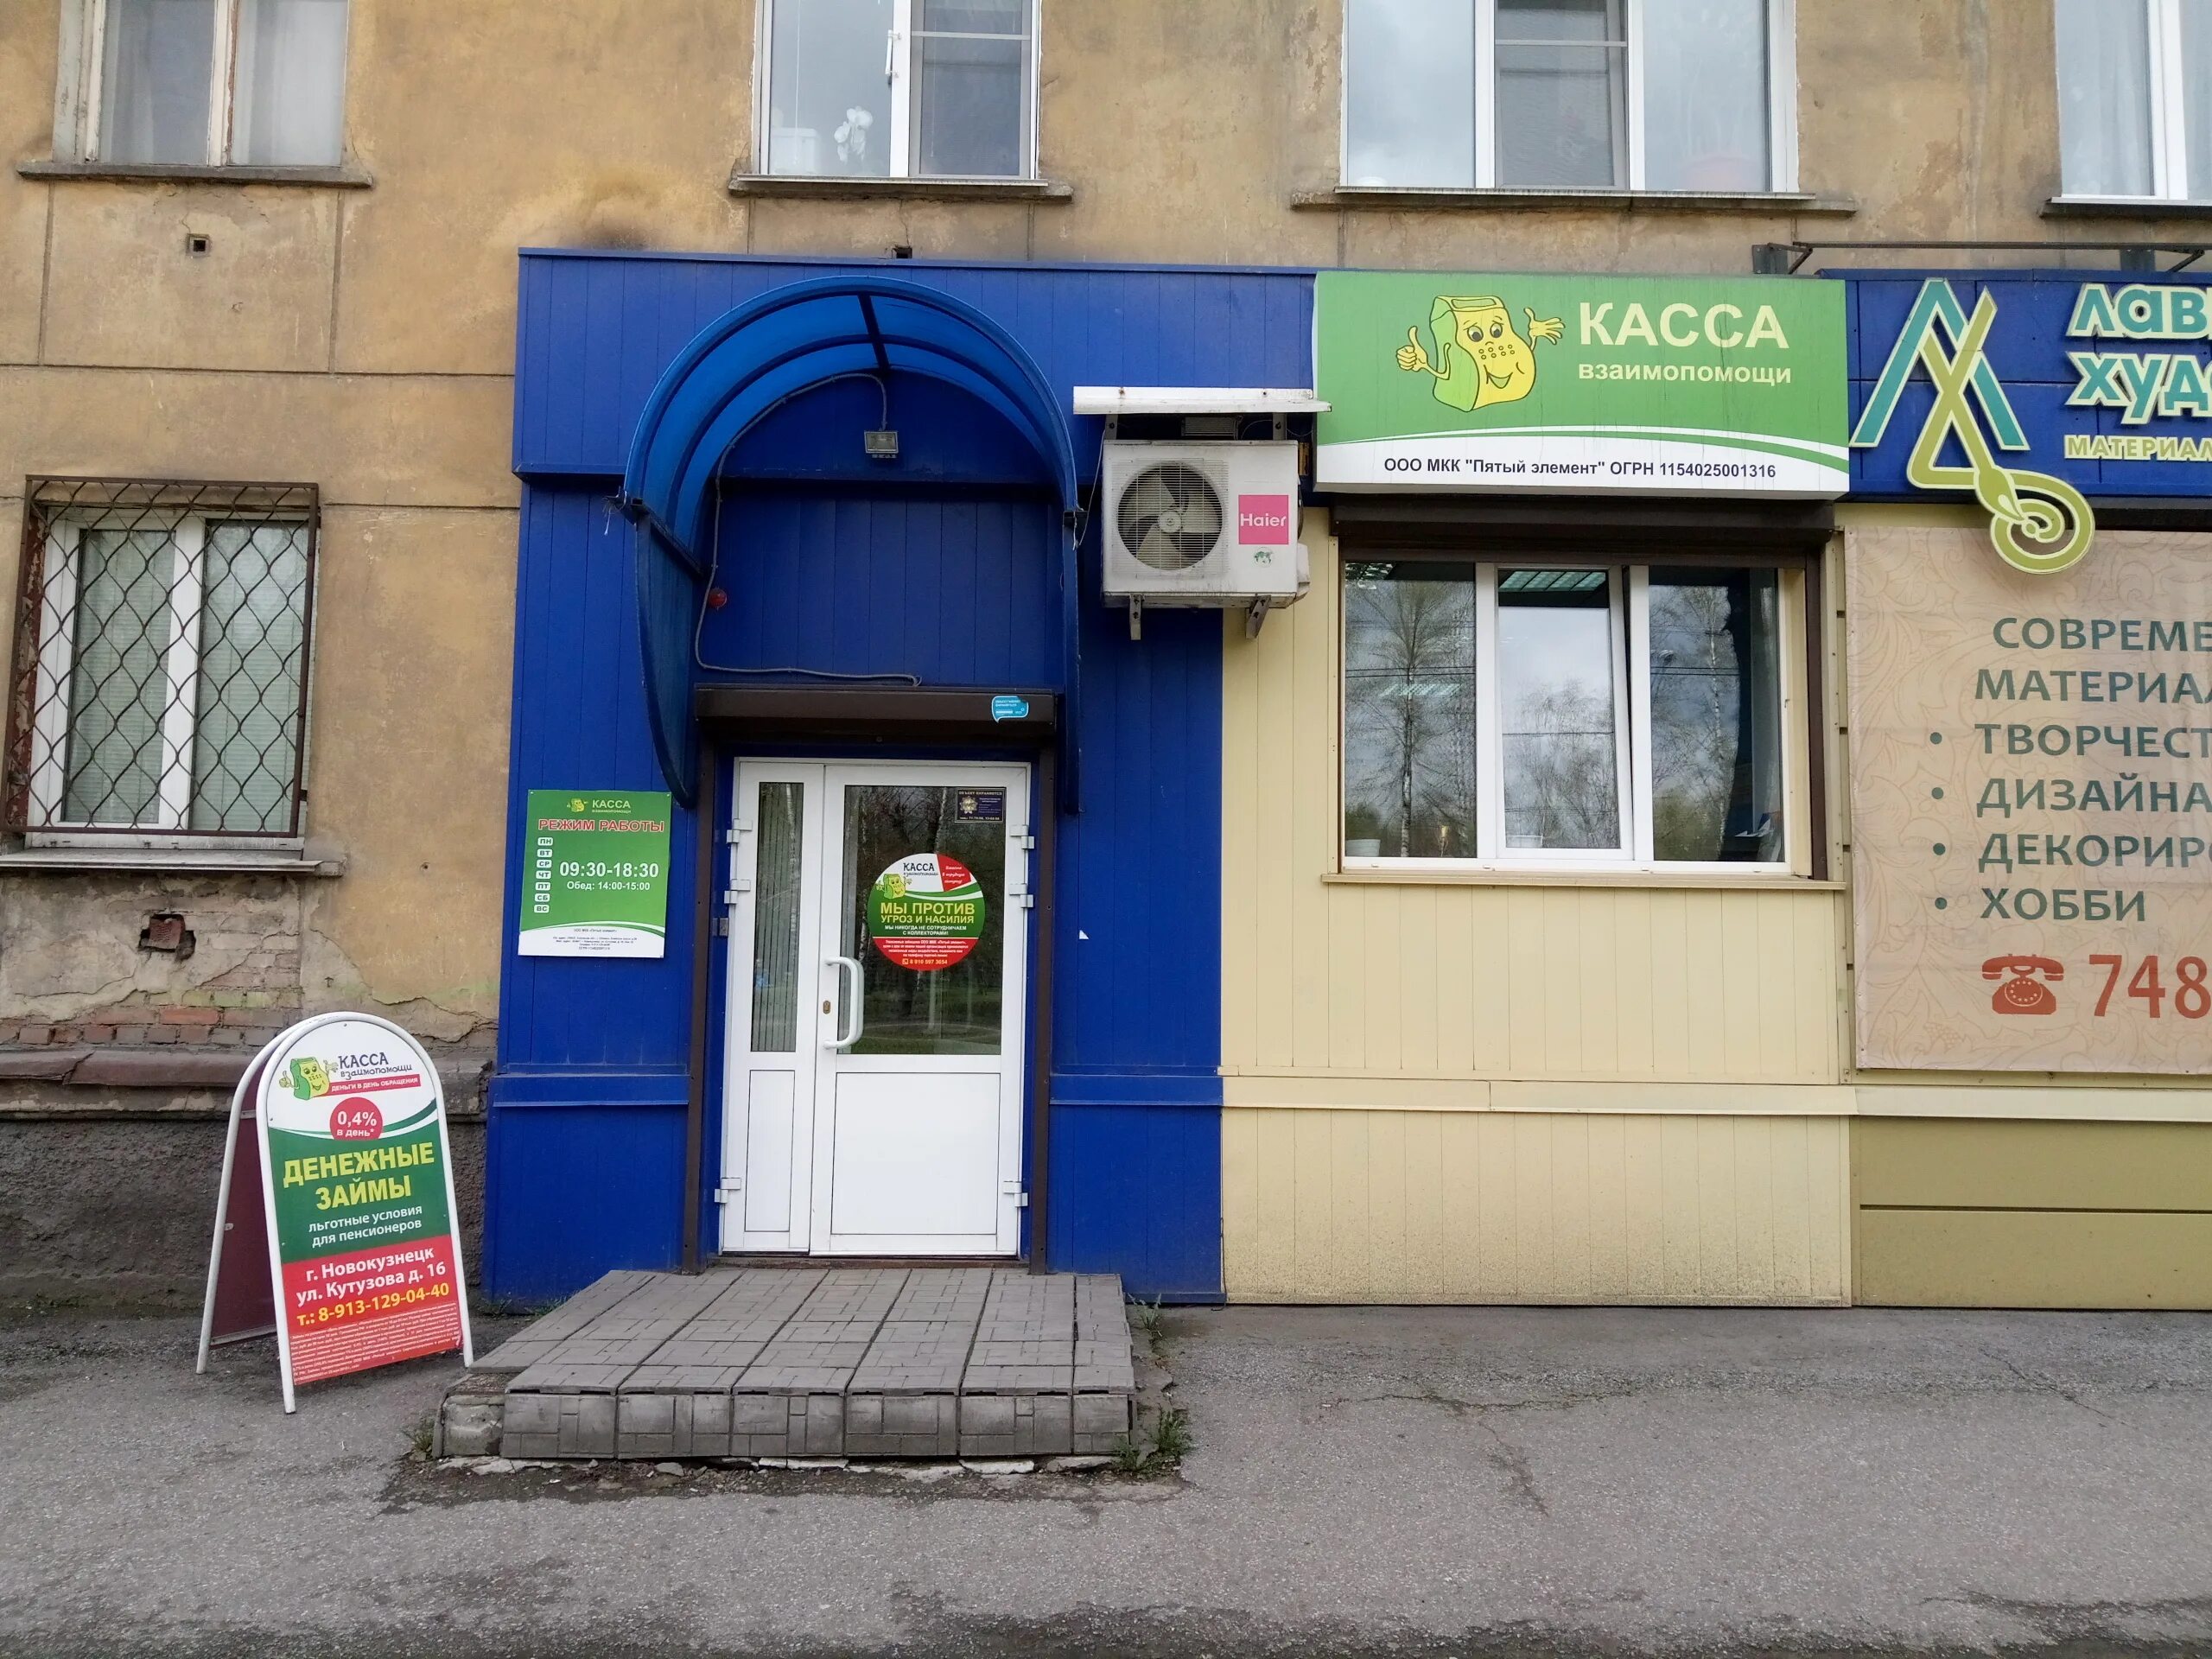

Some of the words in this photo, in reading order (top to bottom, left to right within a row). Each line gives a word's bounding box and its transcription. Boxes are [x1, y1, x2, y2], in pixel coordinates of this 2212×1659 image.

[1580, 302, 1789, 349] КАССА
[1579, 363, 1792, 387] взаимопомощи
[1384, 458, 1422, 472] ООО
[1427, 459, 1461, 472] МКК
[1465, 459, 1526, 474] "Пятый
[1531, 461, 1605, 474] элемент"
[1610, 461, 1654, 475] ОГРН
[1659, 462, 1777, 478] 1154025001316
[1240, 513, 1287, 527] Haier
[1974, 668, 2212, 704] МАТЕРИА
[592, 799, 632, 809] КАССА
[538, 819, 595, 831] РЕЖИМ
[599, 820, 664, 833] РАБОТЫ
[1978, 833, 2212, 874] ДЕКОРИР
[559, 861, 659, 878] 09:30-18:30
[903, 862, 935, 872] КАССА
[567, 881, 595, 891] Обед:
[598, 881, 651, 891] 14:00-15:00
[880, 902, 907, 914] МЫ
[912, 903, 976, 915] ПРОТИВ
[1980, 887, 2146, 922] ХОББИ
[880, 915, 912, 924] УГРОЗ
[915, 915, 922, 924] И
[925, 915, 975, 924] НАСИЛИЯ
[2088, 953, 2212, 1020] 748
[338, 1052, 389, 1069] КАССА
[340, 1064, 413, 1081] взаимопомощи
[331, 1083, 357, 1092] ДЕНЬГИ
[363, 1081, 380, 1090] ДЕНЬ
[380, 1077, 418, 1087] ОБРАЩЕНИЯ
[337, 1110, 378, 1128] 0,4%
[283, 1141, 435, 1188] ДЕНЕЖНЫЕ
[315, 1175, 411, 1211] ЗАЙМЫ
[308, 1213, 370, 1233] льготные
[372, 1205, 423, 1225] условия
[312, 1235, 336, 1249] для
[339, 1219, 423, 1242] пенсионеров
[306, 1269, 319, 1282] г.
[321, 1248, 435, 1279] Новокузнецк
[296, 1289, 323, 1307] ул.
[326, 1273, 404, 1300] Кутузова
[408, 1269, 423, 1285] д.
[427, 1262, 446, 1277] 16
[296, 1313, 315, 1326] т.:
[318, 1282, 449, 1322] 8-913-129-04-40
